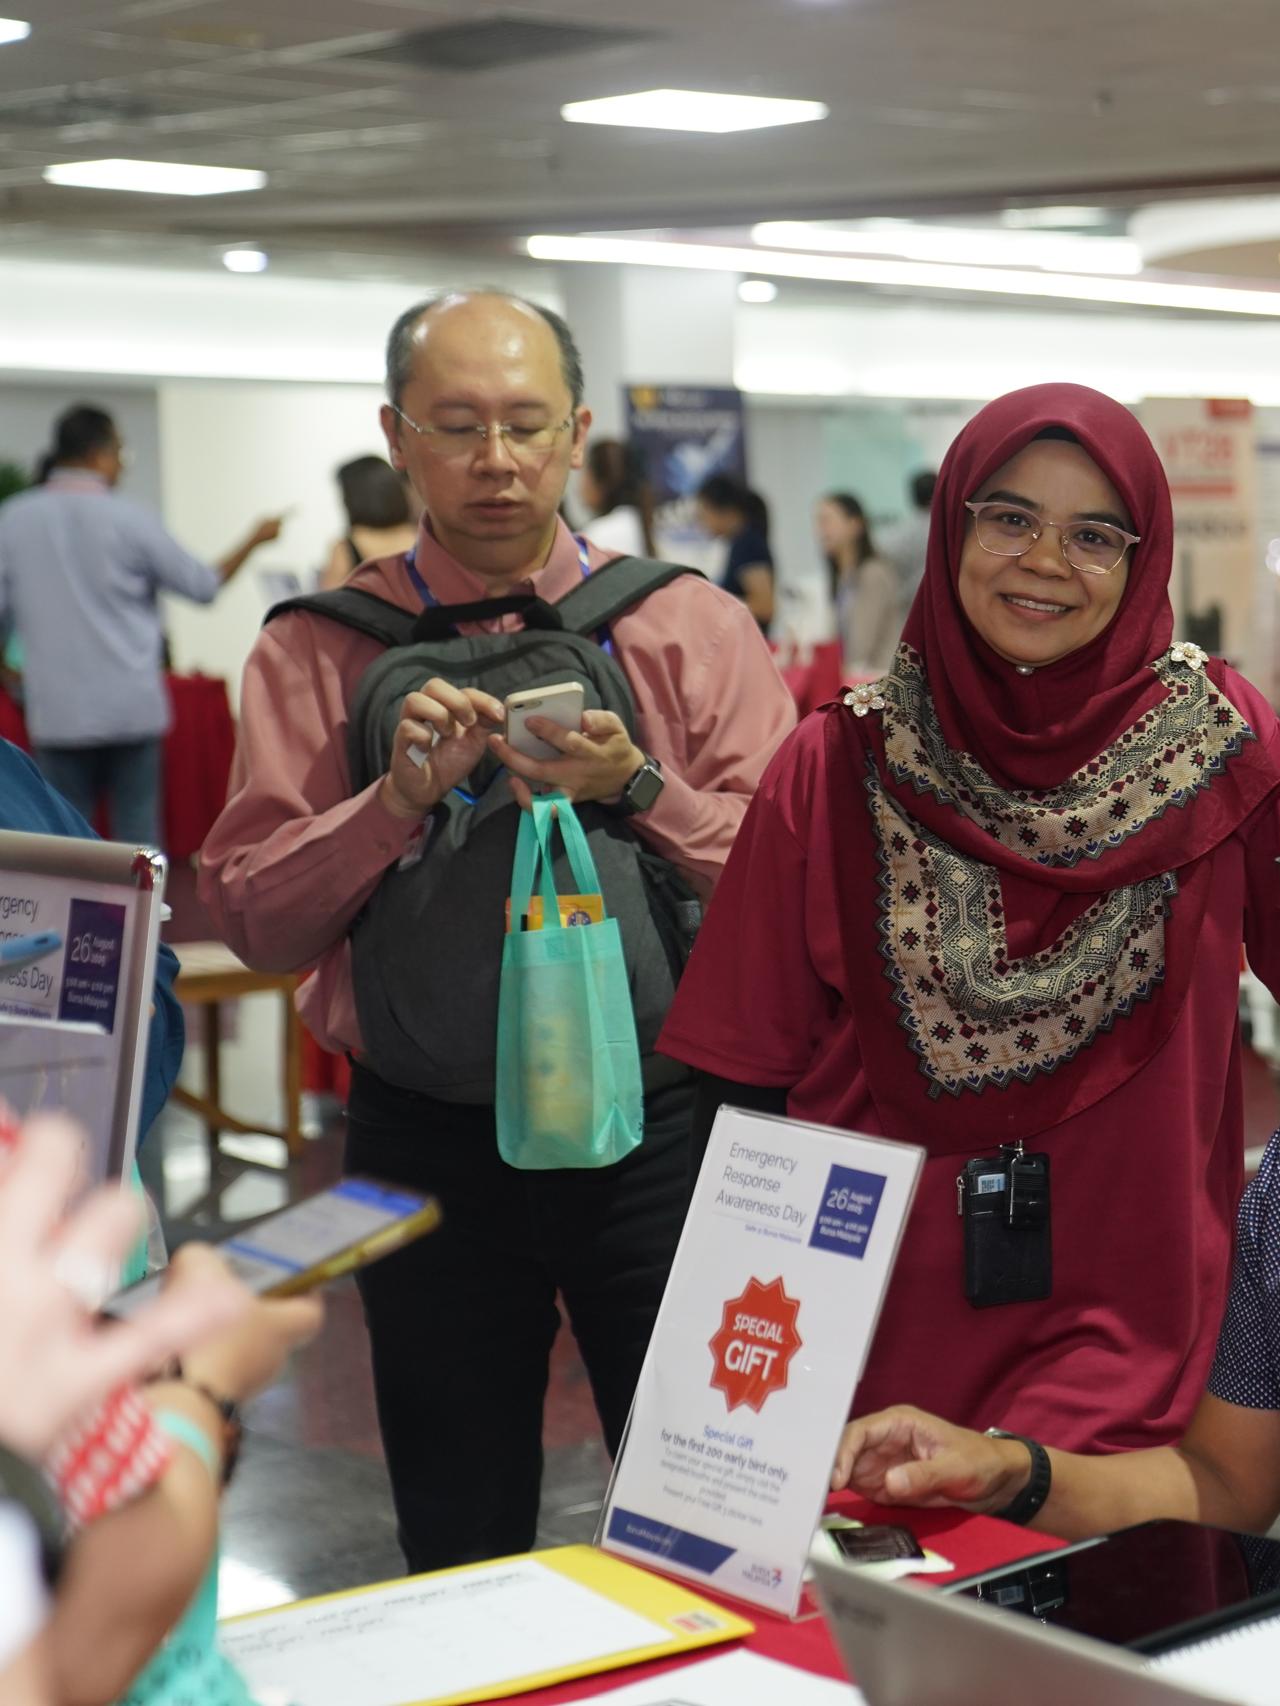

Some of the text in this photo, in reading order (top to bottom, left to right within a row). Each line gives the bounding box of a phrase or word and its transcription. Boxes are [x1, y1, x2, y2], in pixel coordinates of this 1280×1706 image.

[71, 933, 92, 963] 26
[30, 966, 54, 998] Day
[729, 1142, 798, 1175] Emergency
[722, 1165, 781, 1193] Response
[715, 1189, 807, 1228] Awareness Day
[826, 1187, 849, 1211] 26
[732, 1312, 784, 1344] SPECIAL
[724, 1339, 779, 1382] GIFT
[703, 1424, 754, 1452] Special Gift
[660, 1428, 788, 1482] for the first 200 early bird only
